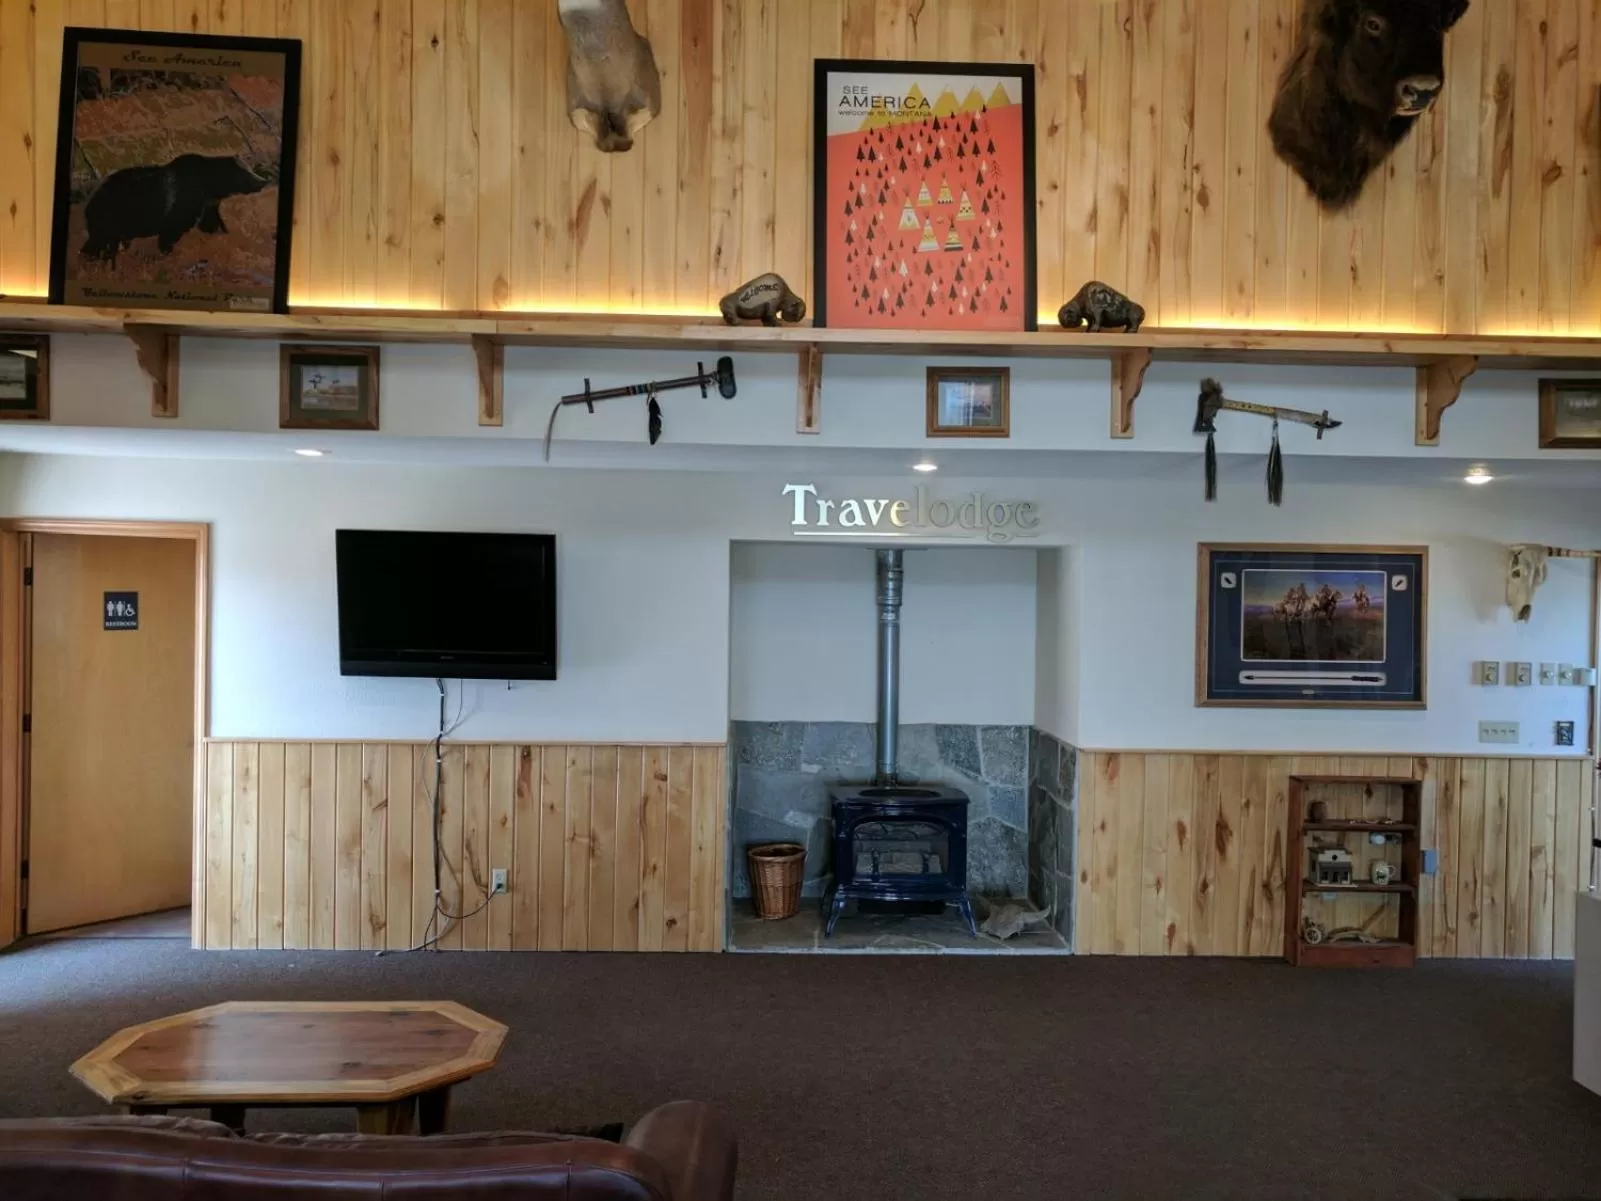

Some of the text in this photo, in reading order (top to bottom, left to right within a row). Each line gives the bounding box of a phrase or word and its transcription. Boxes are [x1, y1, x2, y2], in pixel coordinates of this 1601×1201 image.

[123, 50, 241, 66] See America
[843, 86, 868, 95] SEE
[839, 95, 931, 109] AMERICA
[782, 483, 1040, 542] Travelodge
